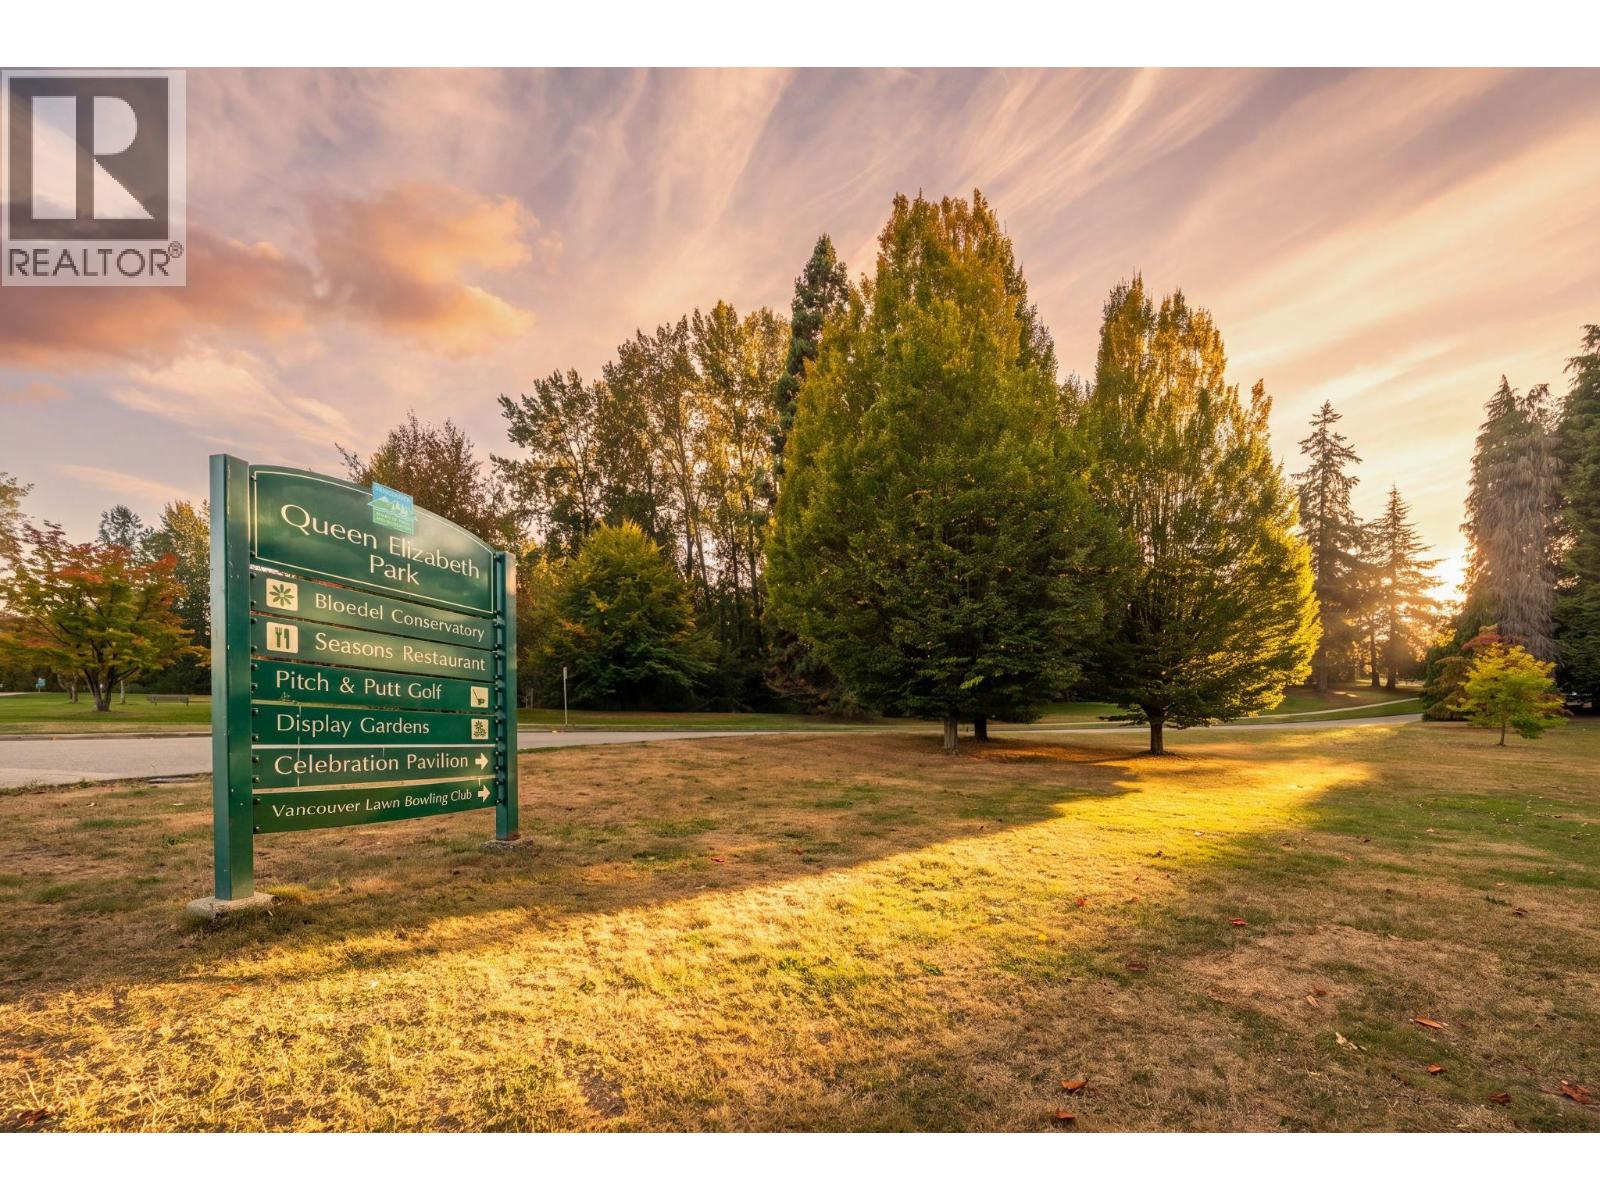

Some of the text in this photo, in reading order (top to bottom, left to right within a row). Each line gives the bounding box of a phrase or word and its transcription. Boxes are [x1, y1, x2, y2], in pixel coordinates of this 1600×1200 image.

[280, 504, 378, 550] Queen
[389, 535, 480, 579] Elizabeth
[369, 554, 420, 586] Park
[315, 593, 485, 642] Bloedel Conservatory
[315, 632, 486, 671] Seasons Restaurant
[276, 670, 442, 700] Pitch & Putt Golf
[276, 714, 430, 737] Display Gardens
[274, 752, 469, 775] Celebration Pavilion
[272, 788, 473, 818] Vancouver Lawn Bowling Club
